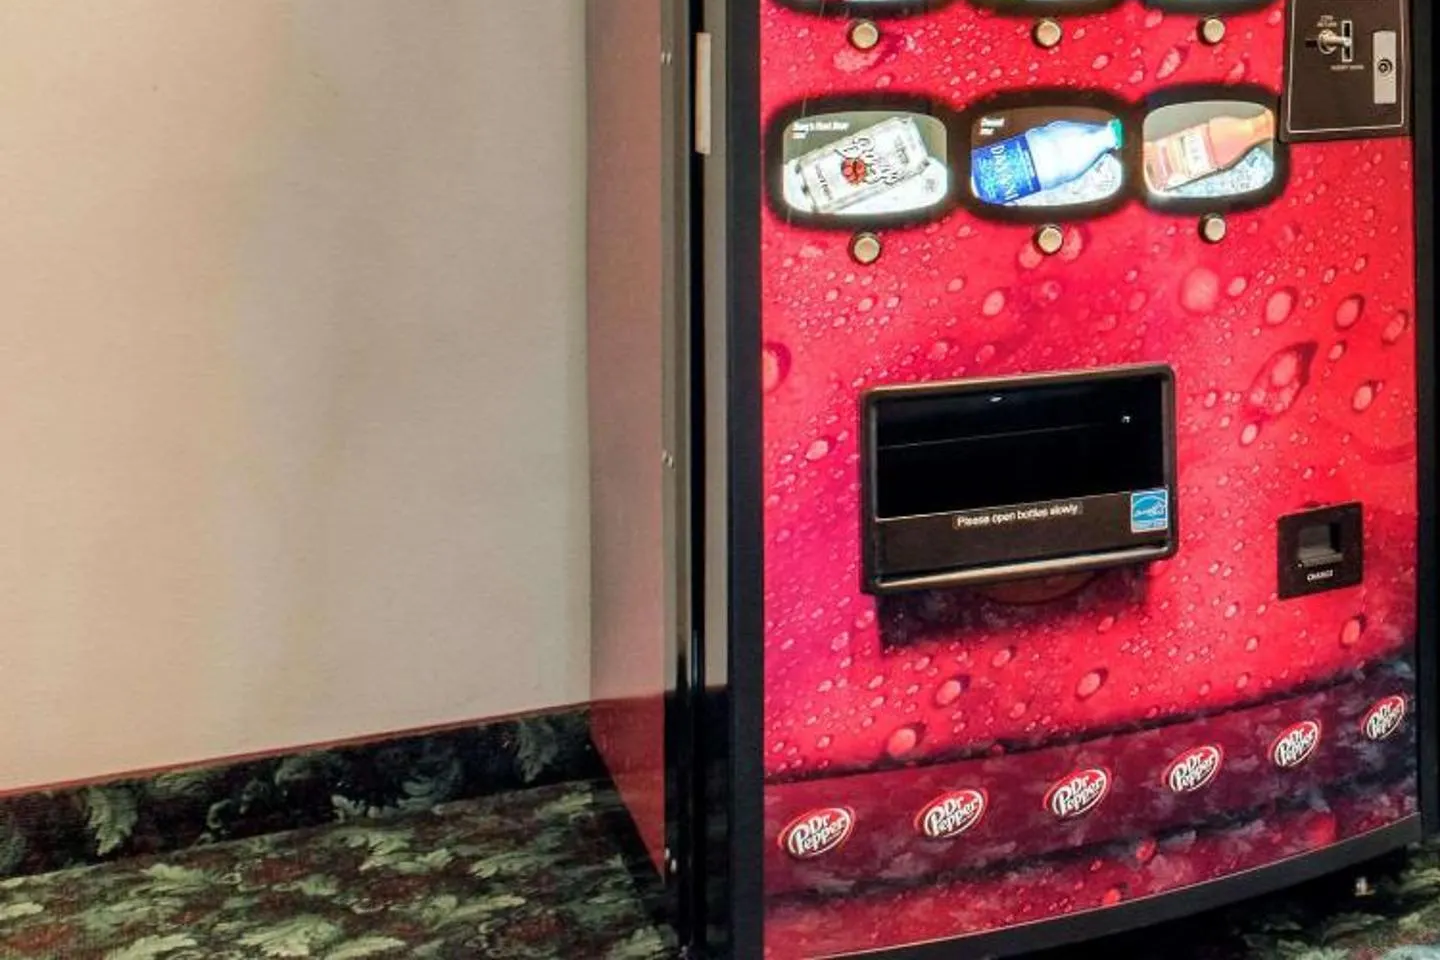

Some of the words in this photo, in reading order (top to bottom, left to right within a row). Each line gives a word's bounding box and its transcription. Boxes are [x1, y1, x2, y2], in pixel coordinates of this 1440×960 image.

[956, 515, 989, 527] Please
[992, 513, 1016, 525] open
[1017, 506, 1048, 520] bottles
[1050, 503, 1079, 516] slowly
[1170, 754, 1215, 791] Pepper
[1186, 752, 1203, 771] Dr
[1052, 777, 1105, 816] Pepper
[1070, 775, 1090, 795] Dr
[925, 799, 979, 836] Pepper
[944, 796, 964, 816] Dr
[808, 814, 831, 833] Dr
[788, 817, 846, 855] Pepper
